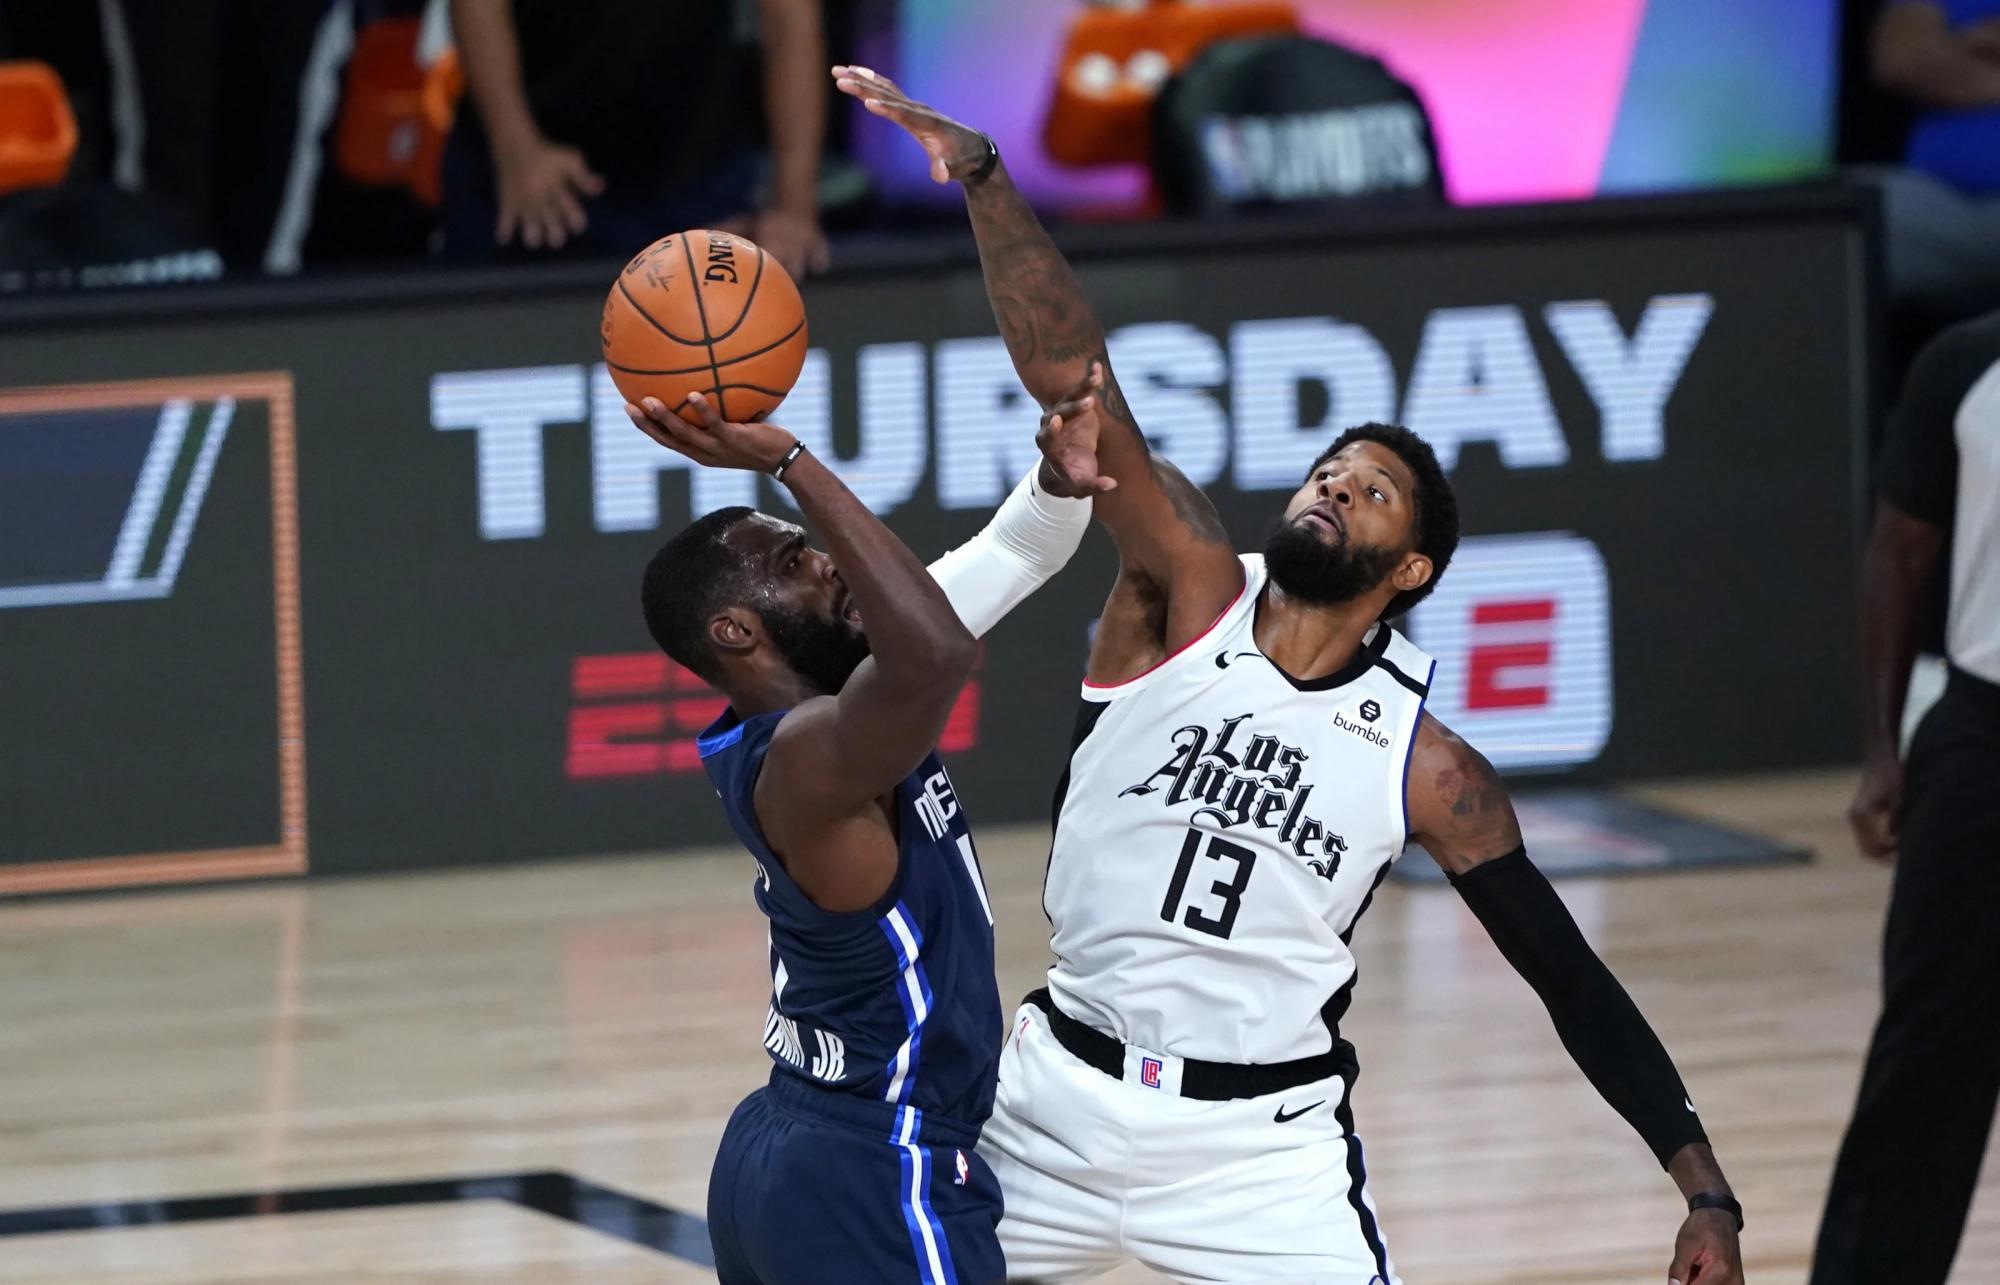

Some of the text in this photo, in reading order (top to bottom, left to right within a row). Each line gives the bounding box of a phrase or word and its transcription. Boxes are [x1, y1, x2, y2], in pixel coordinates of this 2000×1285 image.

[1201, 713, 1309, 791] Los
[1333, 711, 1389, 748] bumble
[1118, 725, 1348, 882] Angeles
[1160, 827, 1257, 940] 13
